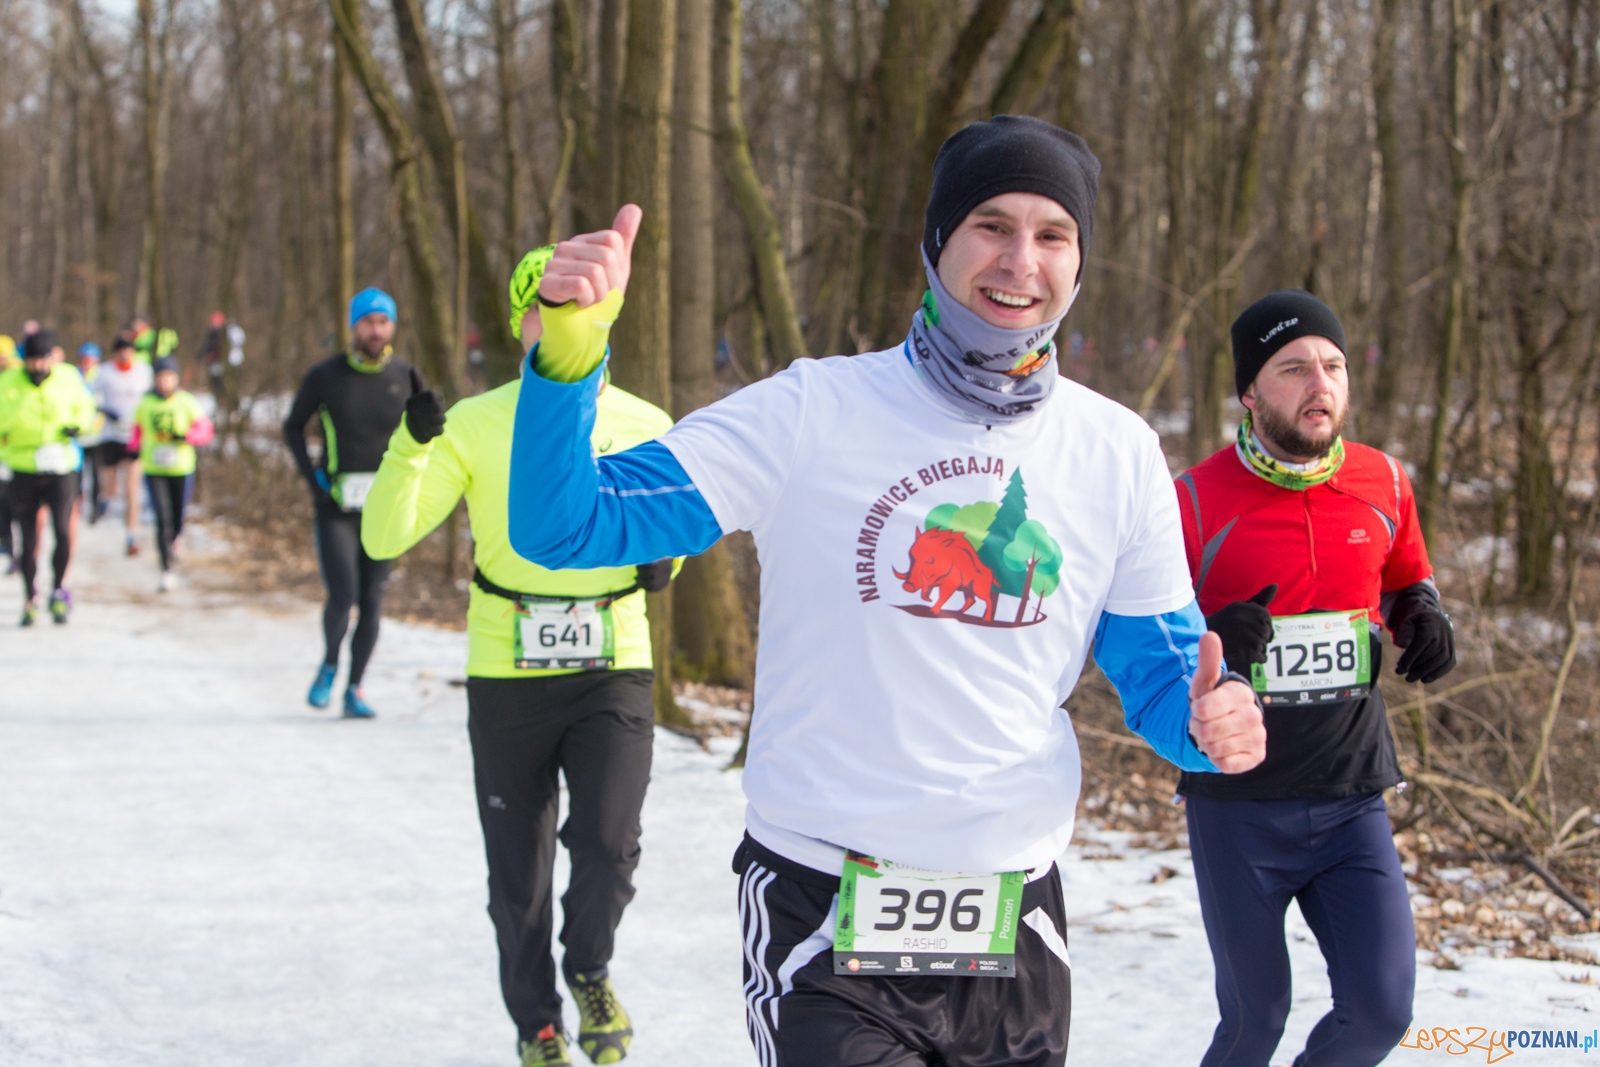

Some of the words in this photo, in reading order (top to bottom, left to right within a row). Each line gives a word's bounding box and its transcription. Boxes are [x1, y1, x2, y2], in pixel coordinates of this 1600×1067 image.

[856, 476, 918, 603] NARAMOWICE
[917, 456, 1004, 486] BIEGAJĄ
[539, 623, 590, 647] 641
[1269, 639, 1356, 677] 1258
[1300, 677, 1334, 688] MARCIN
[874, 887, 984, 932] 396
[999, 898, 1014, 940] Poznań
[903, 937, 948, 950] RASHID
